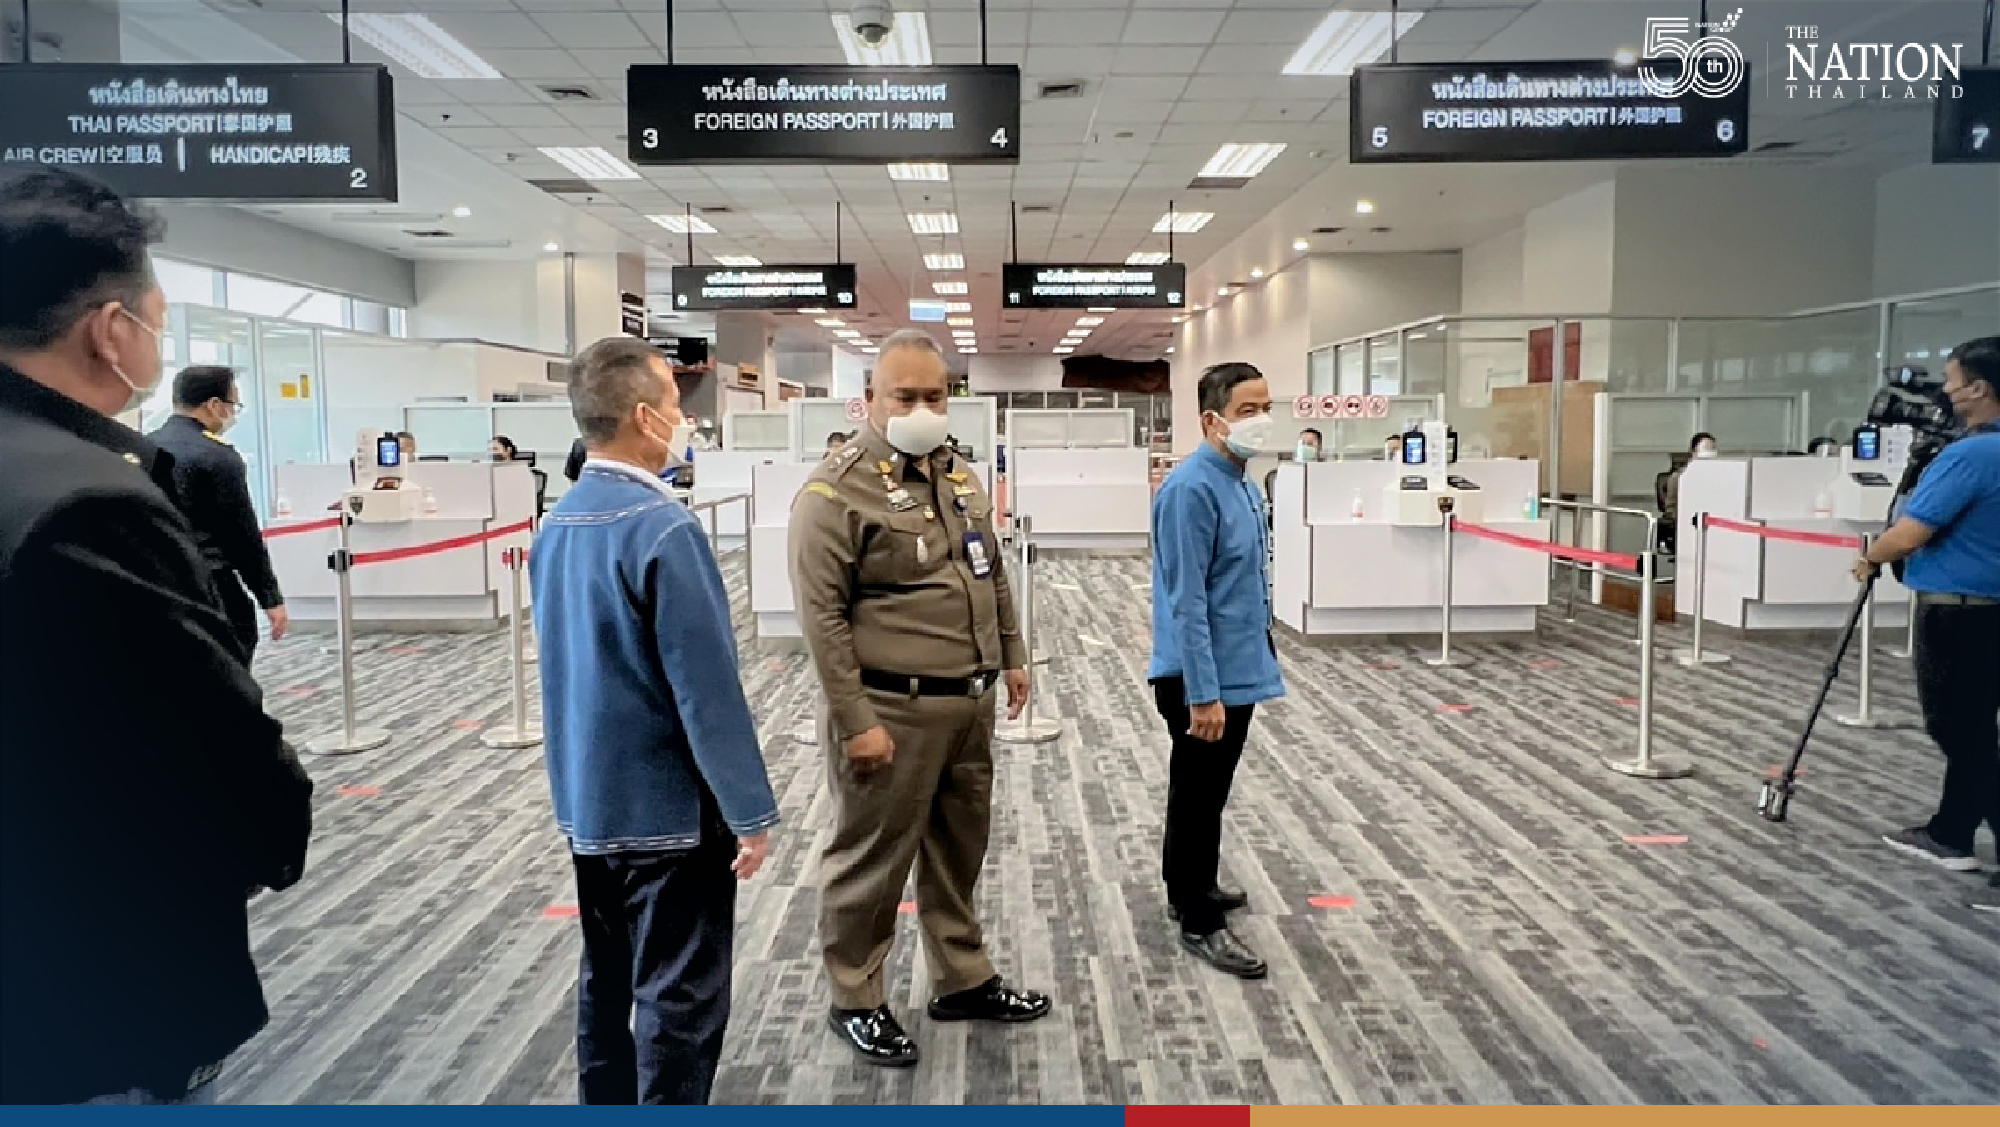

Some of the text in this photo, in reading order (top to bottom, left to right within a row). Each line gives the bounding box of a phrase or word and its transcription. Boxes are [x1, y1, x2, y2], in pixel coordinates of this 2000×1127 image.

[68, 115, 111, 133] THAI
[117, 115, 216, 133] PASSPORT
[694, 112, 778, 131] FOREIGN
[783, 112, 881, 131] PASSPORT
[1422, 109, 1506, 129] FOREIGN
[1511, 108, 1606, 128] PASSPORT
[642, 128, 659, 149] 3
[990, 128, 1008, 149] 4
[1371, 126, 1389, 148] 5
[1716, 119, 1734, 142] 6
[1971, 124, 1990, 149] 7
[4, 147, 35, 161] AIR
[39, 147, 99, 164] CREW
[210, 146, 307, 164] HANDICAP
[350, 168, 368, 188] 2
